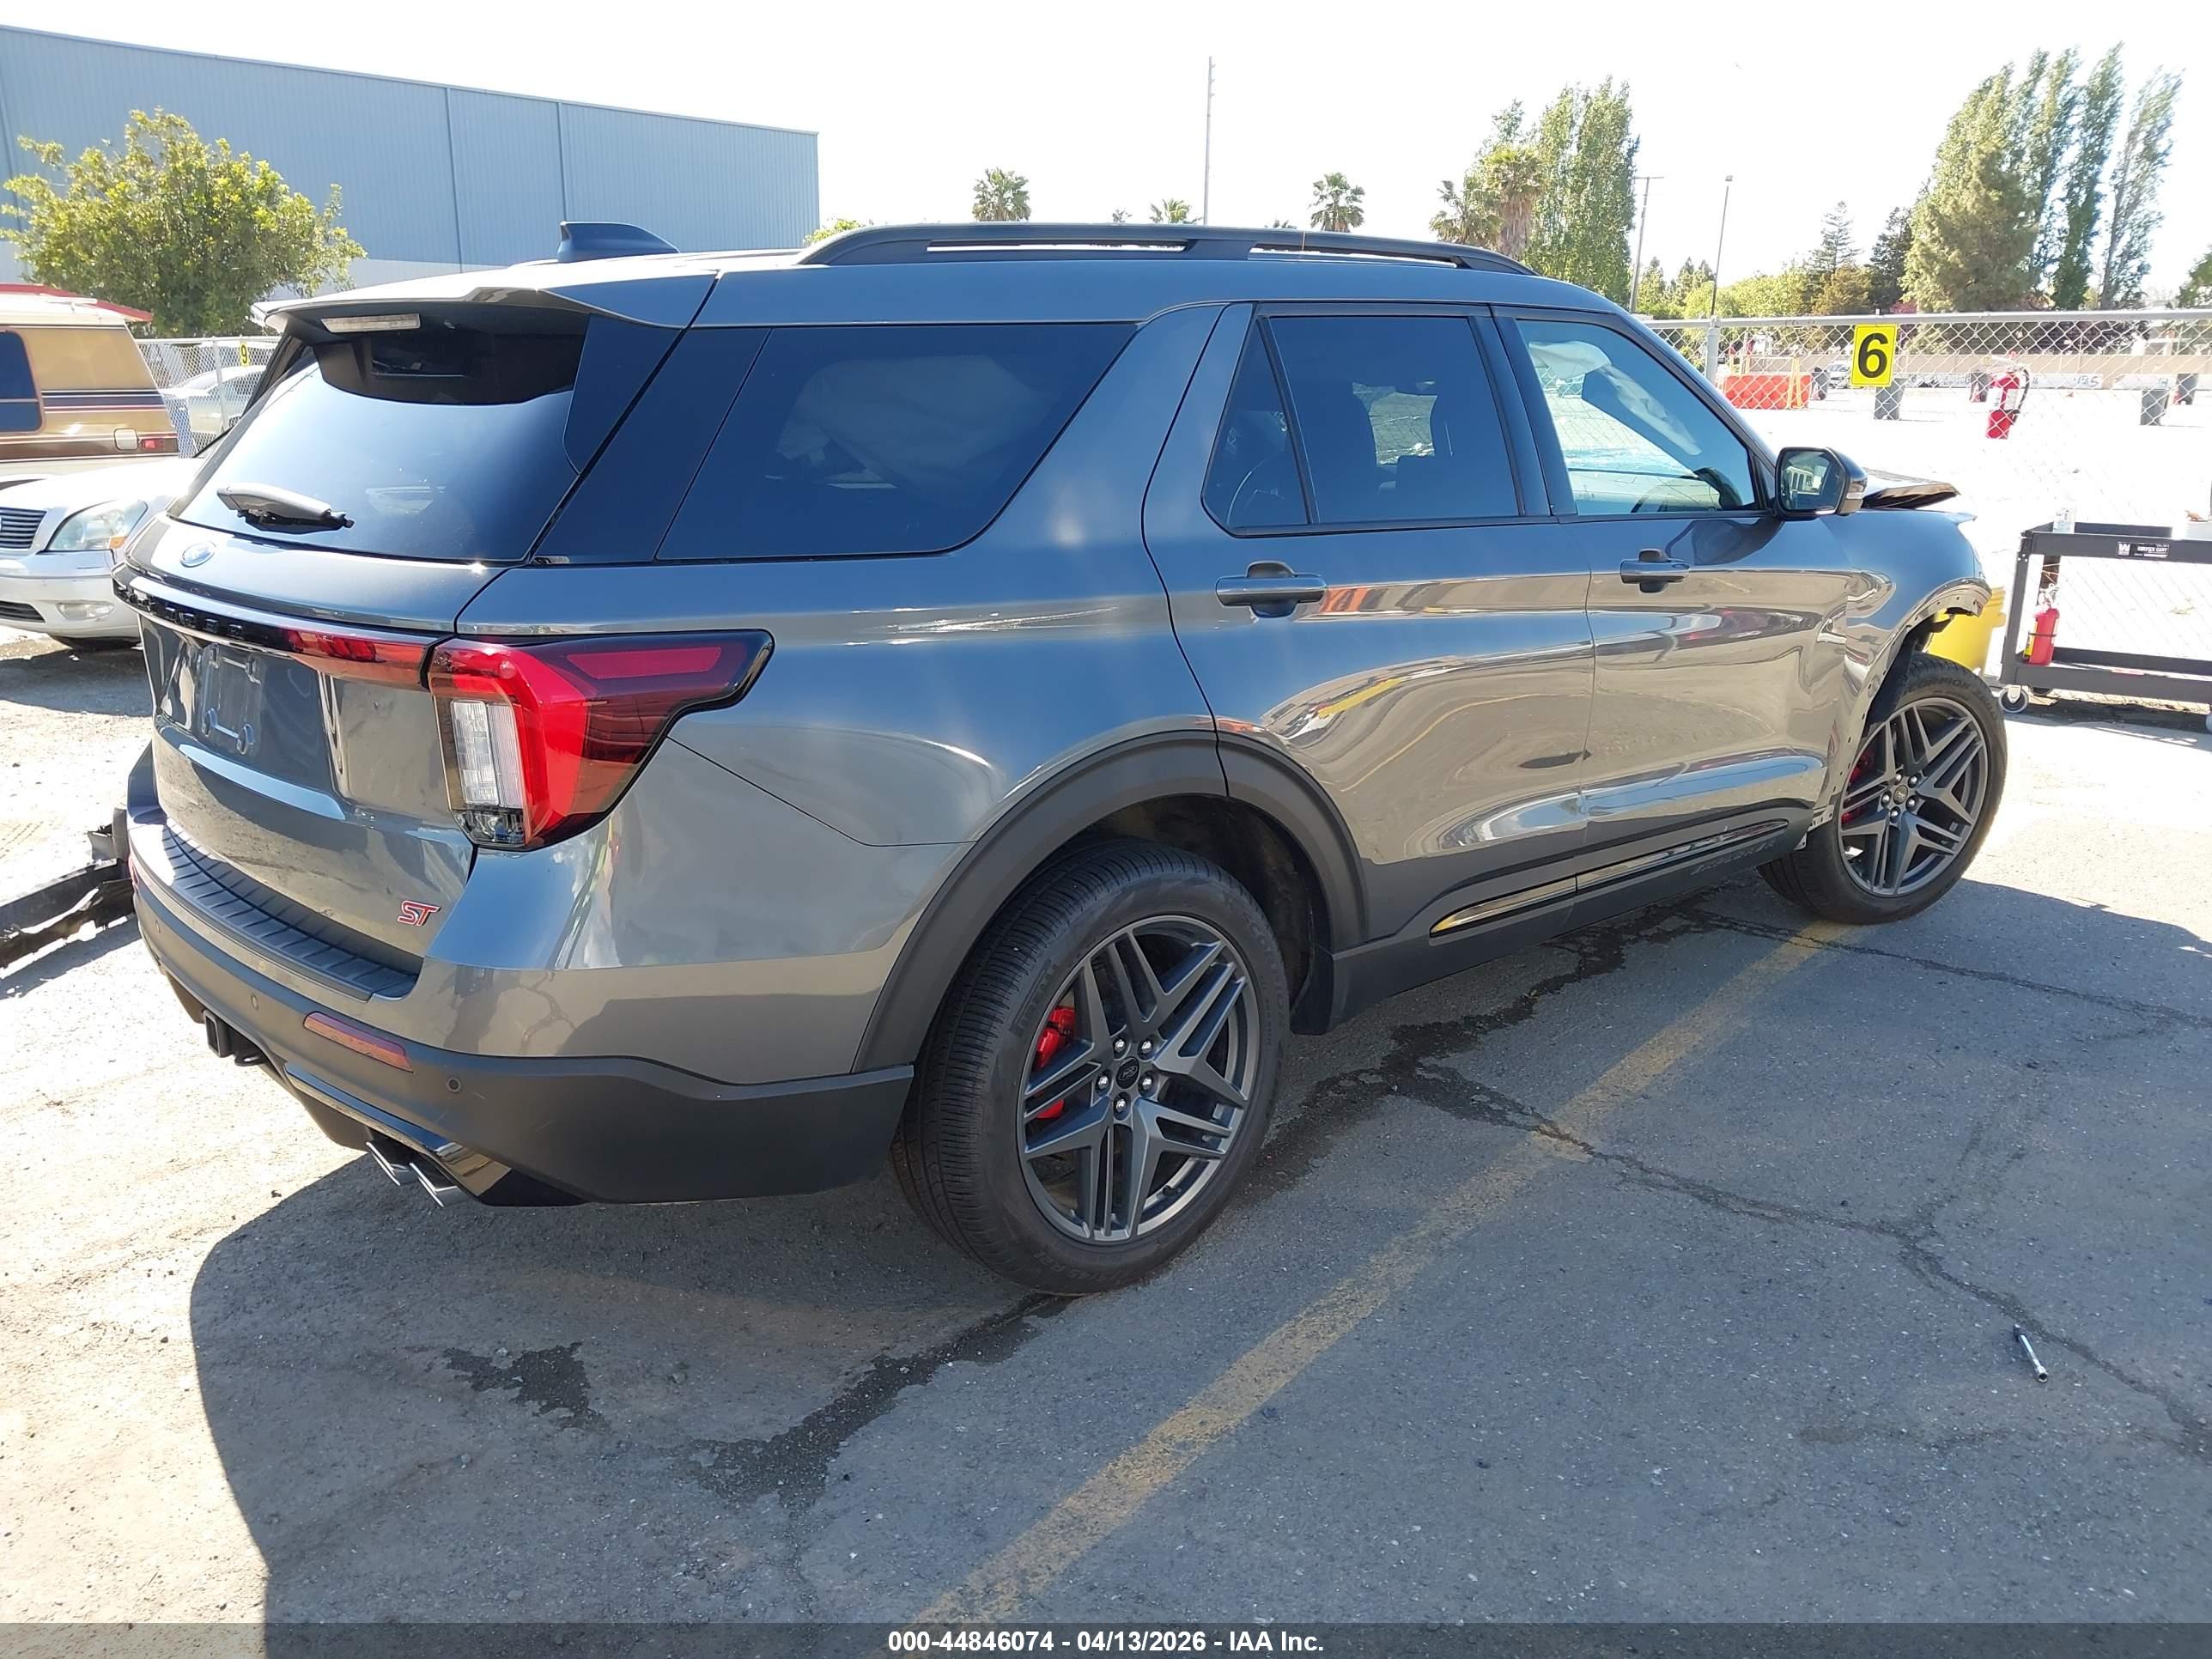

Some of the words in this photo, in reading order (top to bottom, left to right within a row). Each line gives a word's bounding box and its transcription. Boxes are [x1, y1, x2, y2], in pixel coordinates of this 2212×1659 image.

[241, 344, 247, 364] 9
[1858, 332, 1889, 379] 6
[397, 900, 441, 927] ST
